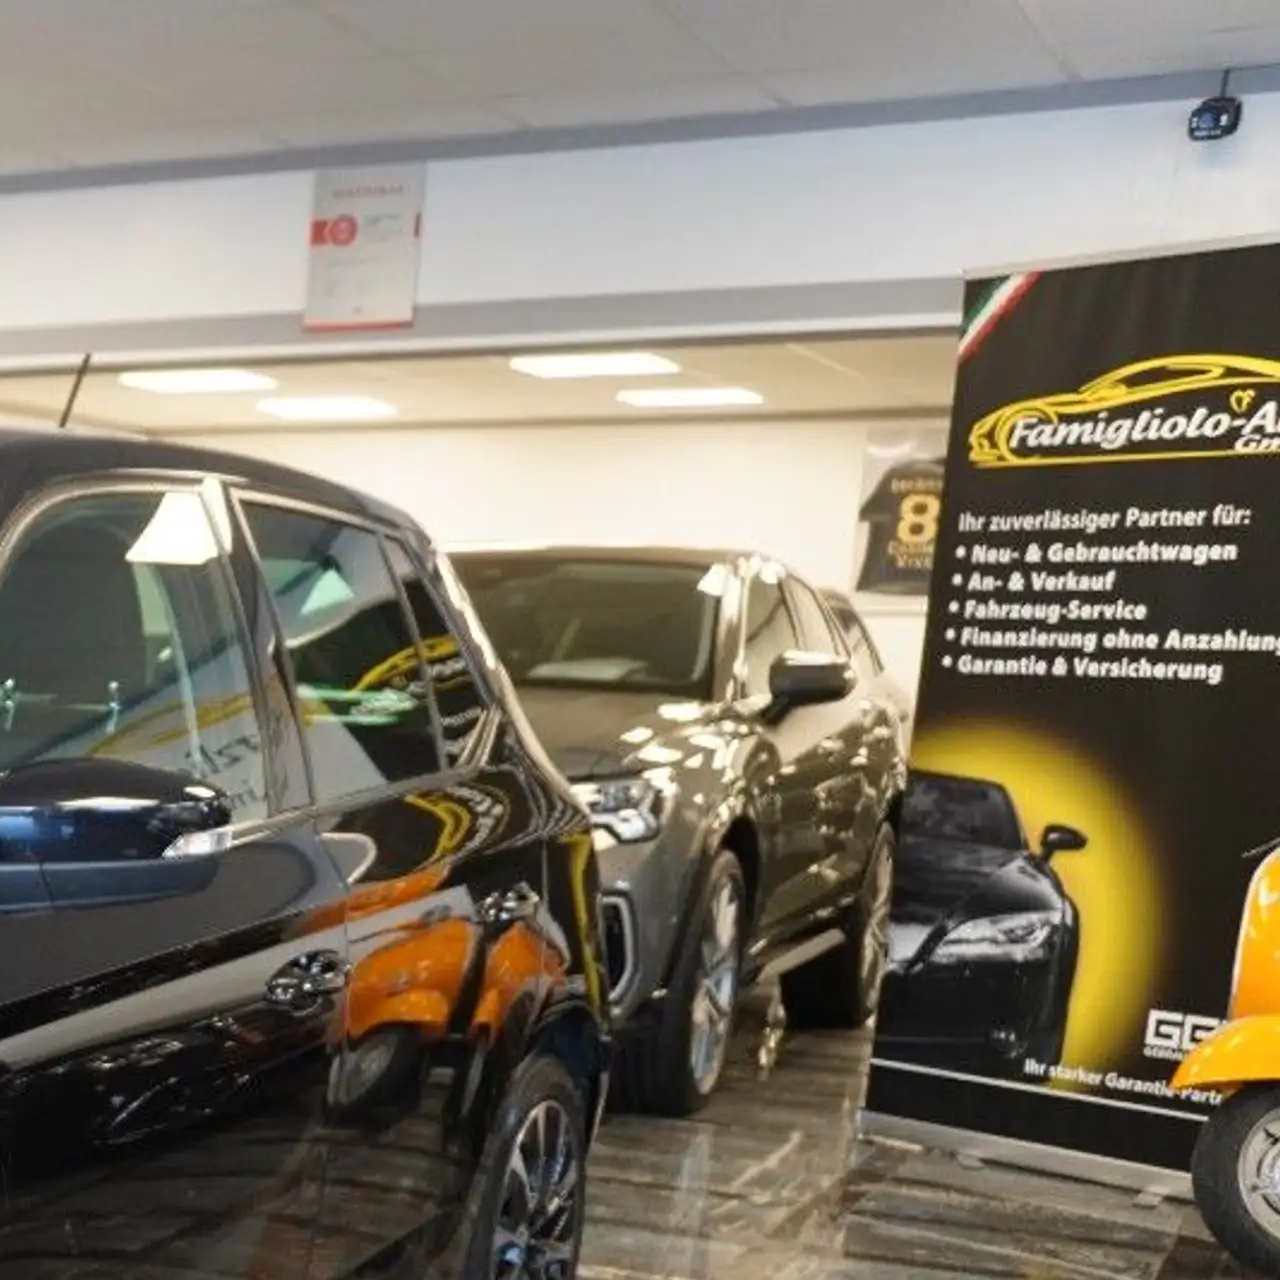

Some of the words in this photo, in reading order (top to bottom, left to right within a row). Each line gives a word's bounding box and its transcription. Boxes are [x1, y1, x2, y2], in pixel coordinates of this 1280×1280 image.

[1008, 400, 1280, 450] Famigliolo-A
[897, 494, 941, 542] 8
[958, 511, 986, 532] Ihr
[989, 509, 1121, 534] zuverlässiger
[1125, 506, 1208, 528] Partner
[1212, 503, 1252, 527] für:
[971, 544, 1020, 564] Neu-
[1025, 542, 1042, 562] &
[1047, 540, 1238, 566] Gebrauchtwagen
[967, 571, 1003, 591] An-
[1007, 571, 1025, 591] &
[1031, 569, 1116, 591] Verkauf
[964, 599, 1147, 624] Fahrzeug-Service
[960, 626, 1098, 653] Finanzierung
[1102, 627, 1159, 649] ohne
[957, 653, 1048, 675] Garantie
[1051, 655, 1068, 676] &
[1073, 656, 1224, 685] Versicherung
[1145, 1009, 1226, 1051] GG
[1024, 1058, 1046, 1076] Ihr
[1048, 1063, 1103, 1086] starker
